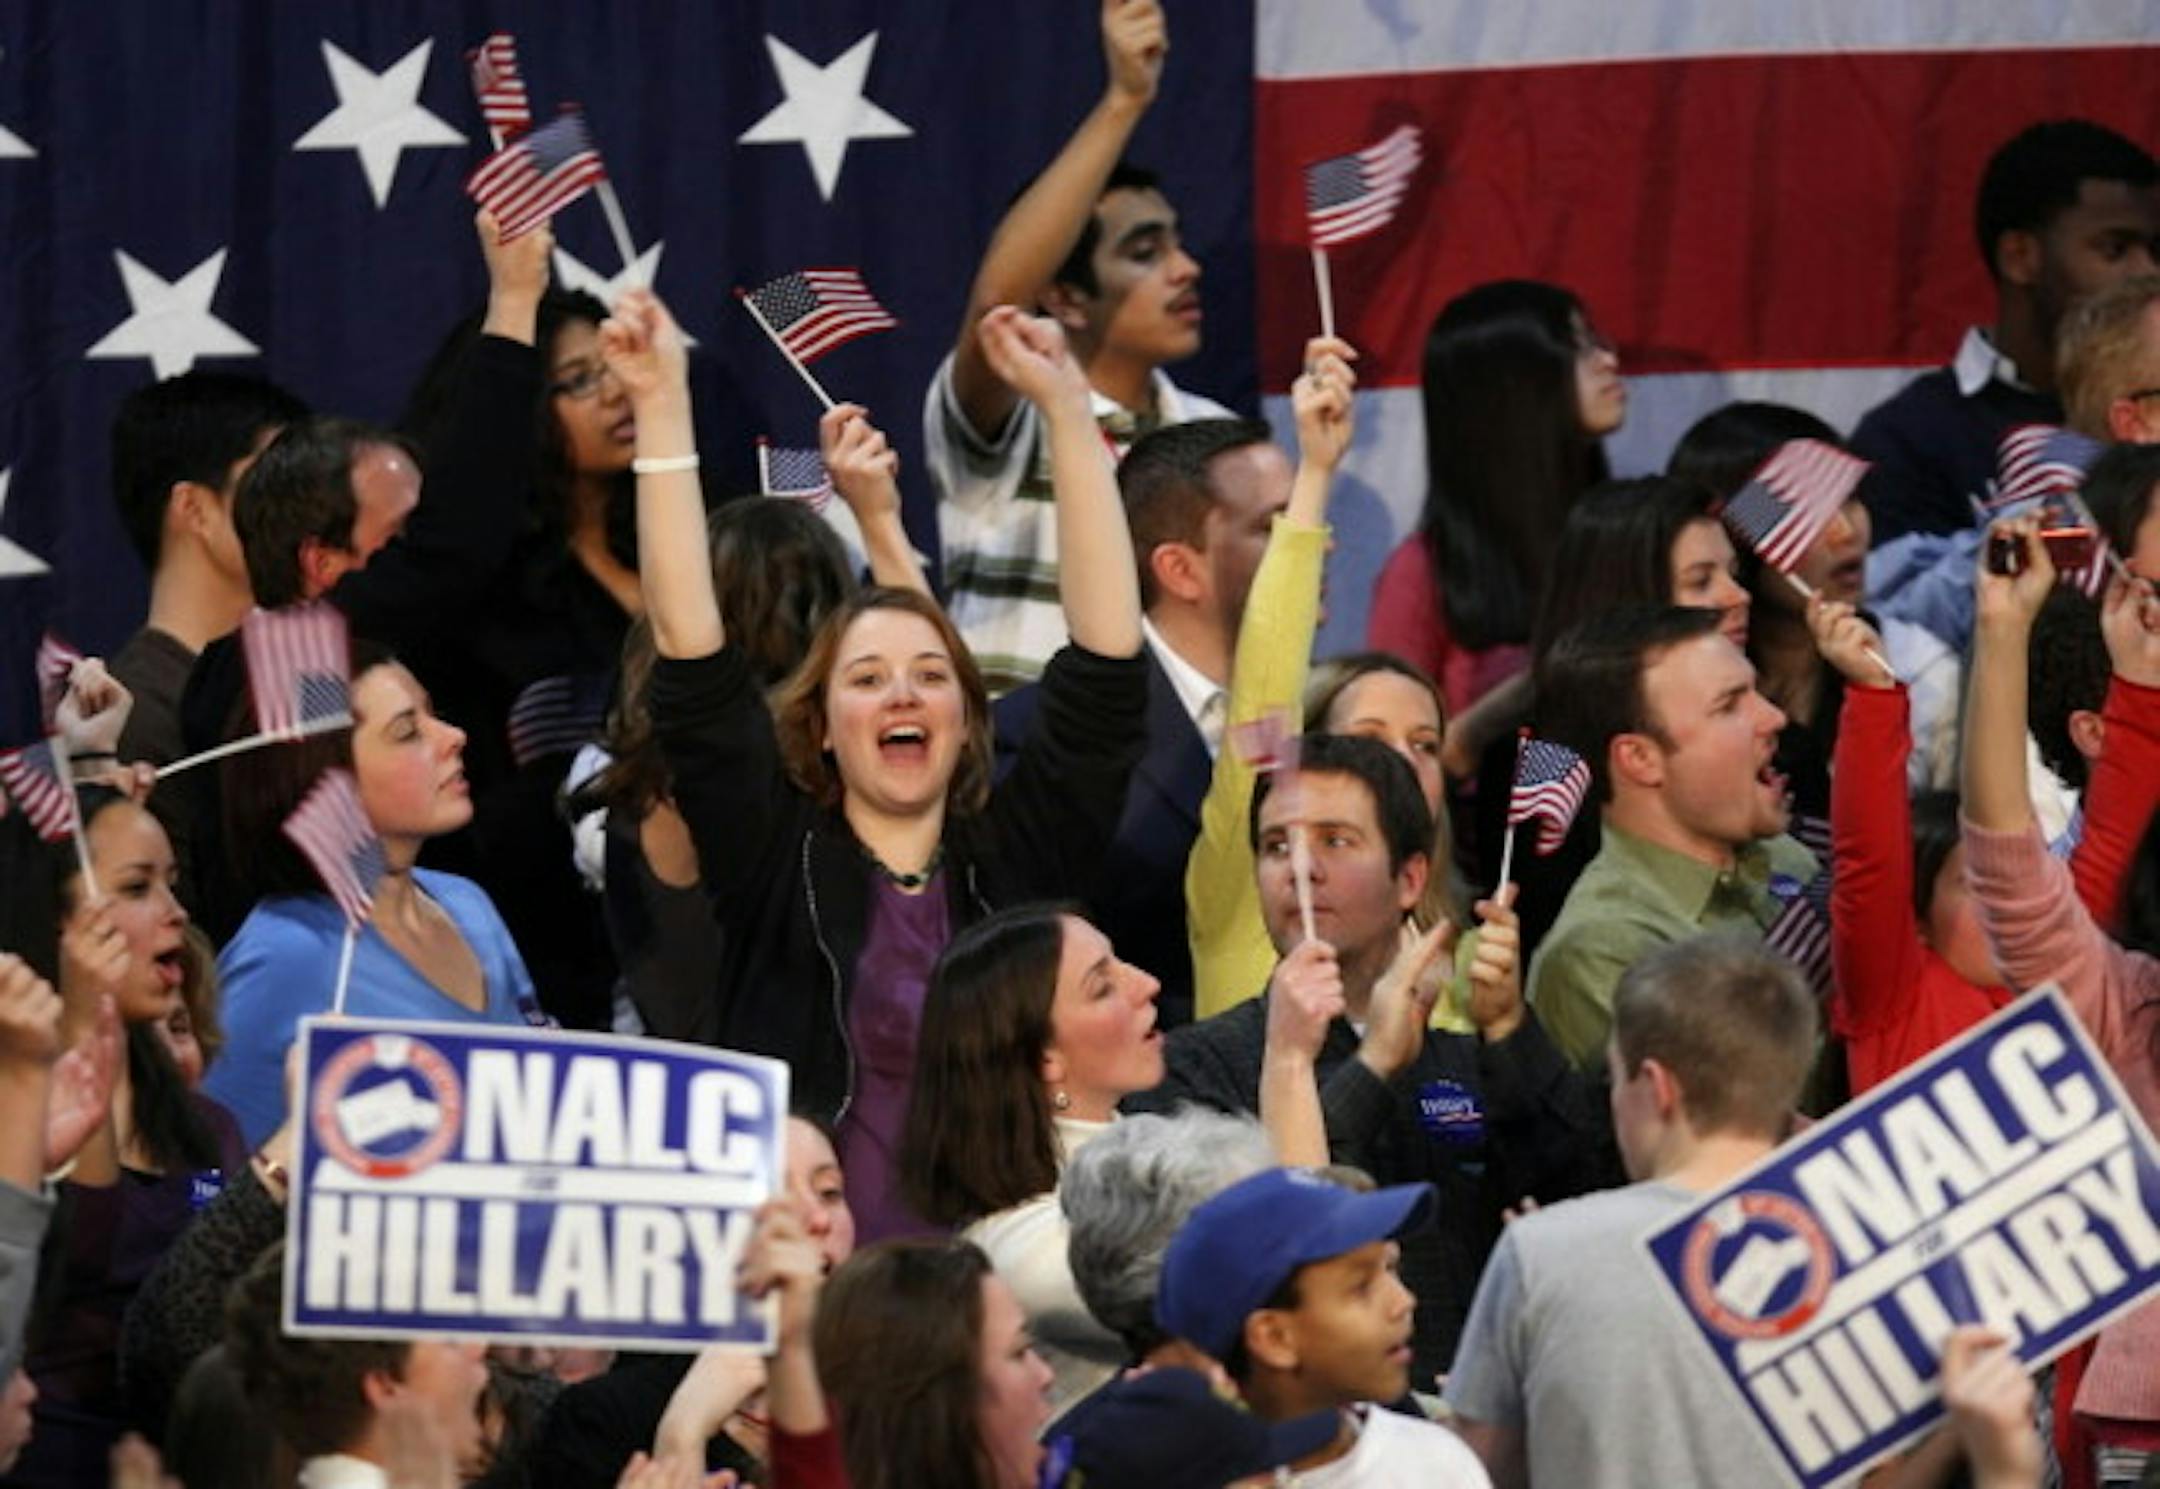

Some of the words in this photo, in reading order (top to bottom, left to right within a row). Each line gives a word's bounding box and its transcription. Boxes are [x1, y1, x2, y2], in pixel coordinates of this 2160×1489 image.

[463, 1048, 765, 1178] NALC
[1794, 1022, 2098, 1265] NALC
[304, 1192, 756, 1327] HILLARY
